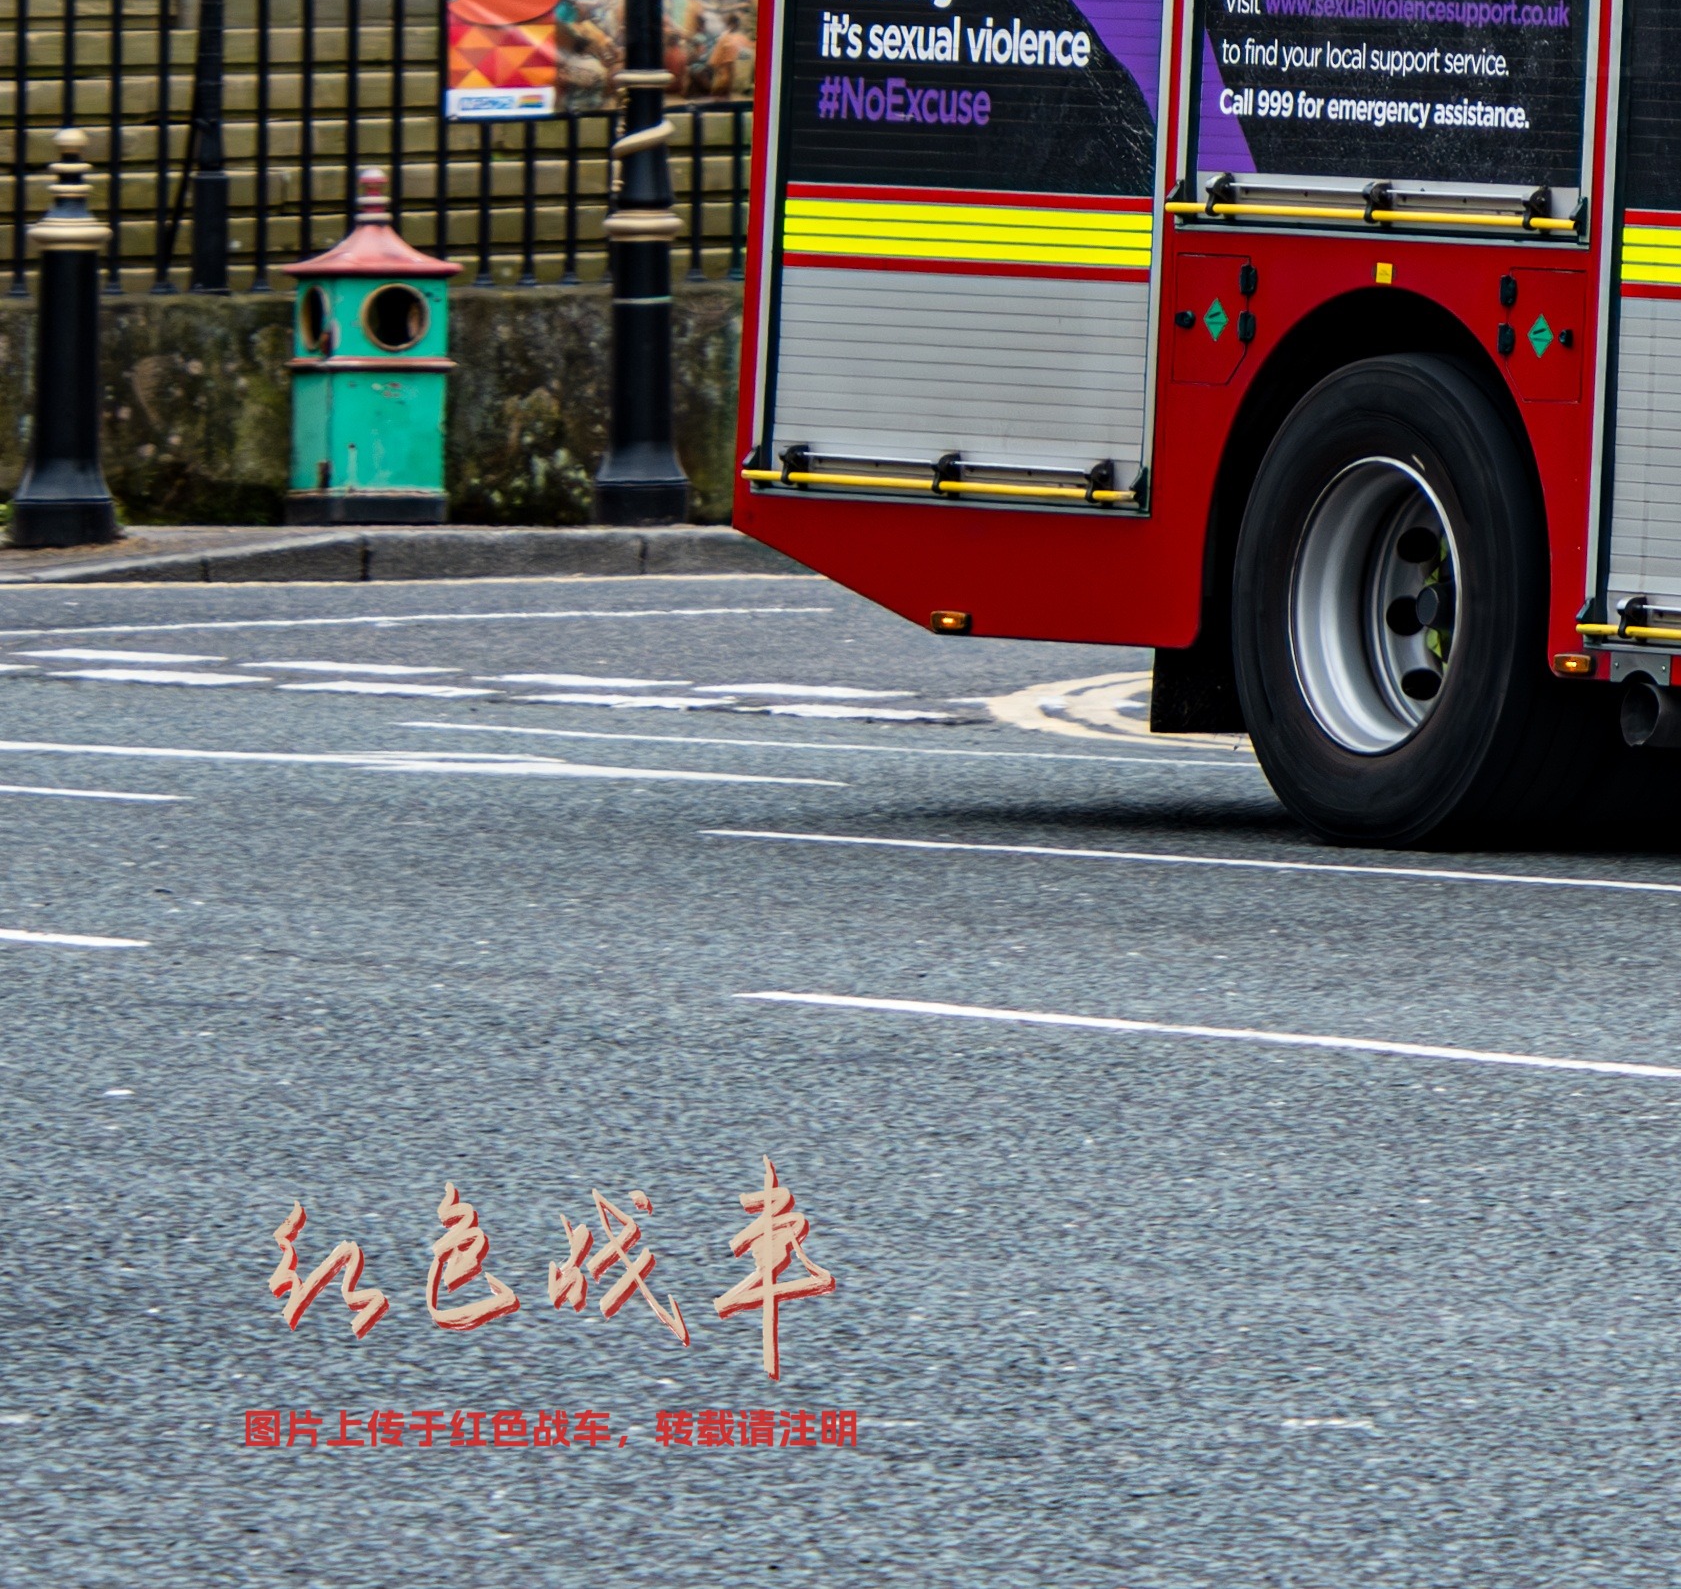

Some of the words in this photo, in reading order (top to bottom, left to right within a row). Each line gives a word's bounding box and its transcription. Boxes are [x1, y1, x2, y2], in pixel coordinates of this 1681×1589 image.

[867, 15, 961, 62] sexual
[967, 16, 1092, 68] violence
[1221, 38, 1242, 65] to
[1244, 38, 1280, 67] find
[1281, 45, 1323, 73] your
[1325, 41, 1367, 71] local
[1370, 47, 1441, 78] support
[1443, 48, 1511, 77] service.
[818, 75, 992, 126] #NoExcuse
[1218, 88, 1254, 116] Call
[1257, 91, 1294, 118] 999
[1296, 91, 1325, 120] for
[1327, 99, 1431, 130] emergency
[1433, 98, 1531, 130] assistance.
